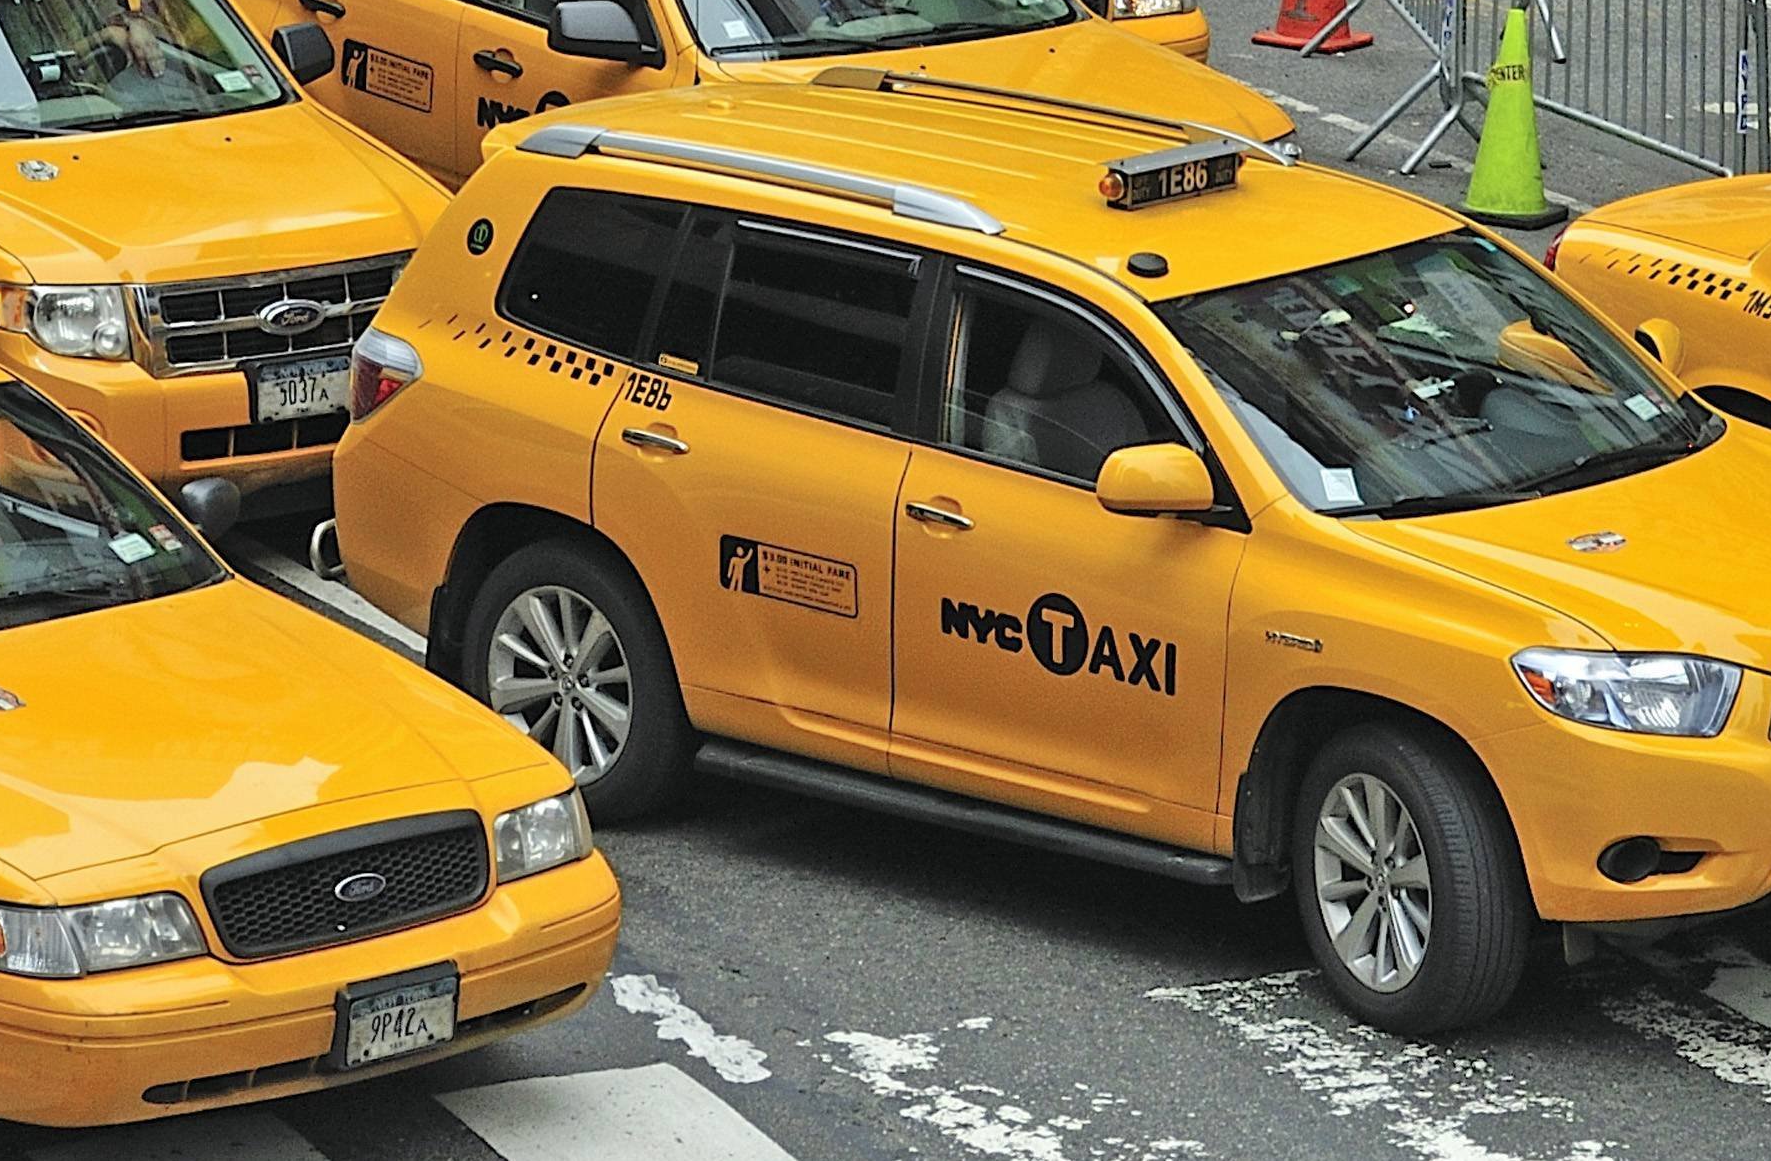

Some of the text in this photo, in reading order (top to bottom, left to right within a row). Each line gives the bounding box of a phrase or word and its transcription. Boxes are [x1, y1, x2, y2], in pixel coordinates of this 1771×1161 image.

[390, 58, 429, 80] INITIAL FARE
[1158, 161, 1208, 198] 1E86
[790, 558, 823, 574] INITIAL
[827, 567, 851, 580] FARE
[941, 593, 1177, 697] NYC TAXI
